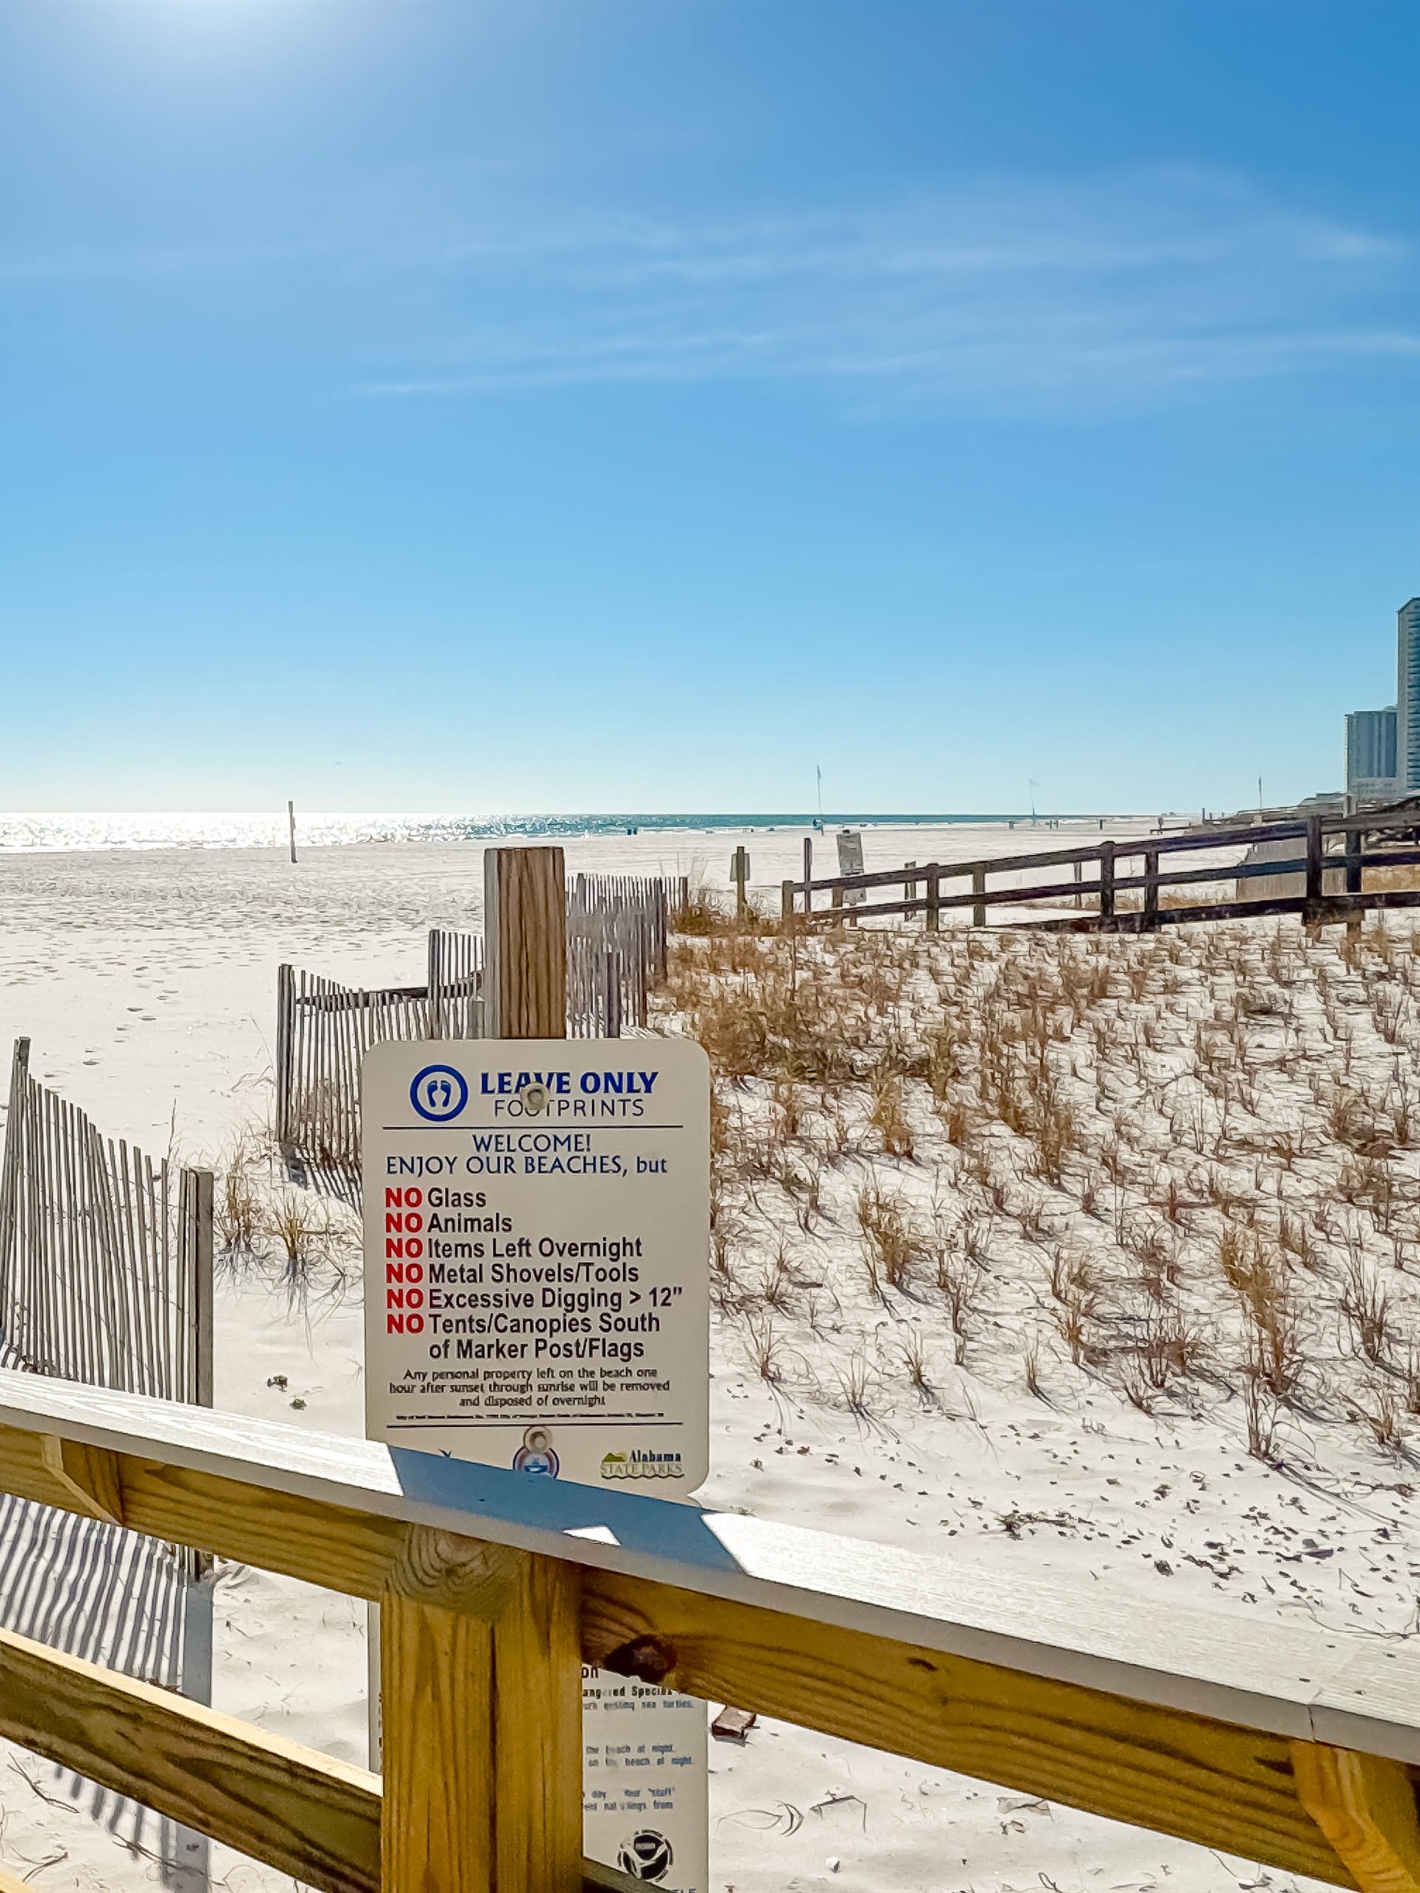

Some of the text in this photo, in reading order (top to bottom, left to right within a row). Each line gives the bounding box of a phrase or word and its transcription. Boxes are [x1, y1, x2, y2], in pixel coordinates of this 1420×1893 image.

[480, 1071, 659, 1095] LEAVE ONLY
[471, 1133, 591, 1153] WELCOME!
[386, 1155, 668, 1178] ENJOY OUR BEACHES, but
[384, 1187, 487, 1208] NO Glass
[384, 1211, 513, 1234] NO Animals
[384, 1236, 643, 1261] NO Items Left Overnight
[385, 1262, 640, 1284] NO Metal Shovels/Tools
[385, 1288, 424, 1309] NO
[429, 1288, 535, 1310] Excessive
[541, 1288, 623, 1312] Digging
[386, 1311, 660, 1338] NO Tents/Canopies South
[429, 1337, 645, 1362] of Marker Post/Flags
[402, 1366, 658, 1382] Any personal property left on the beach one
[389, 1380, 670, 1396] hour after sunset through sunrise will be removed
[458, 1394, 606, 1409] and disposed of overnight
[629, 1449, 682, 1463] Alabama
[600, 1463, 683, 1475] STATE PARKS
